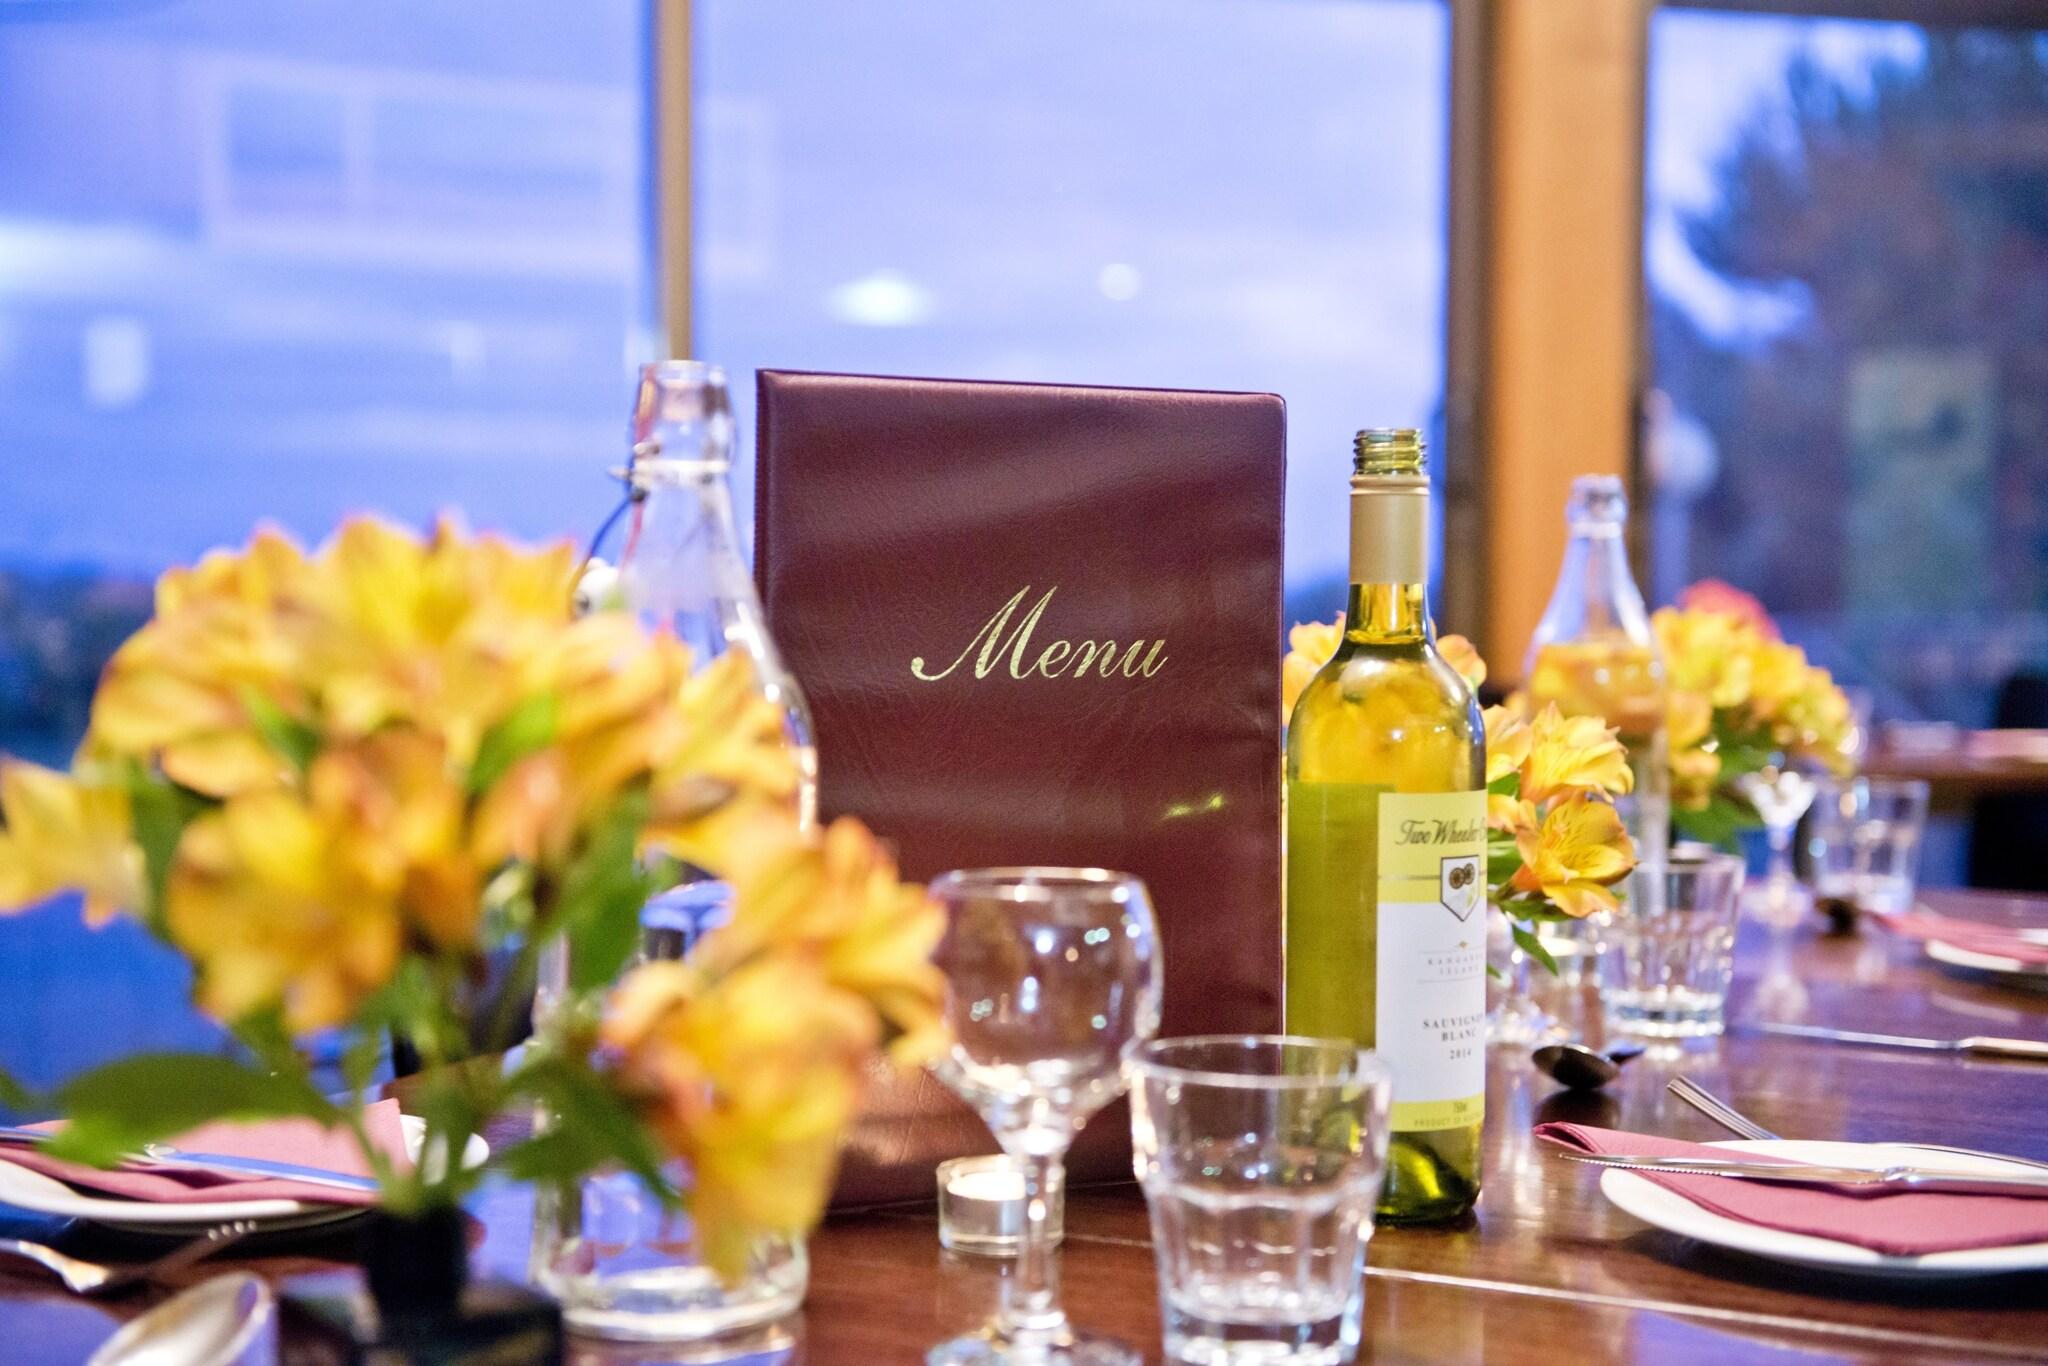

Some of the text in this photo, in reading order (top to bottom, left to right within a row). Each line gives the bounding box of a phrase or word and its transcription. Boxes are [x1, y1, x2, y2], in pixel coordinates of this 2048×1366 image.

[910, 585, 1168, 681] Menu
[1395, 819, 1431, 845] Two
[1441, 1027, 1476, 1042] BLANC
[1449, 1048, 1471, 1060] 2014
